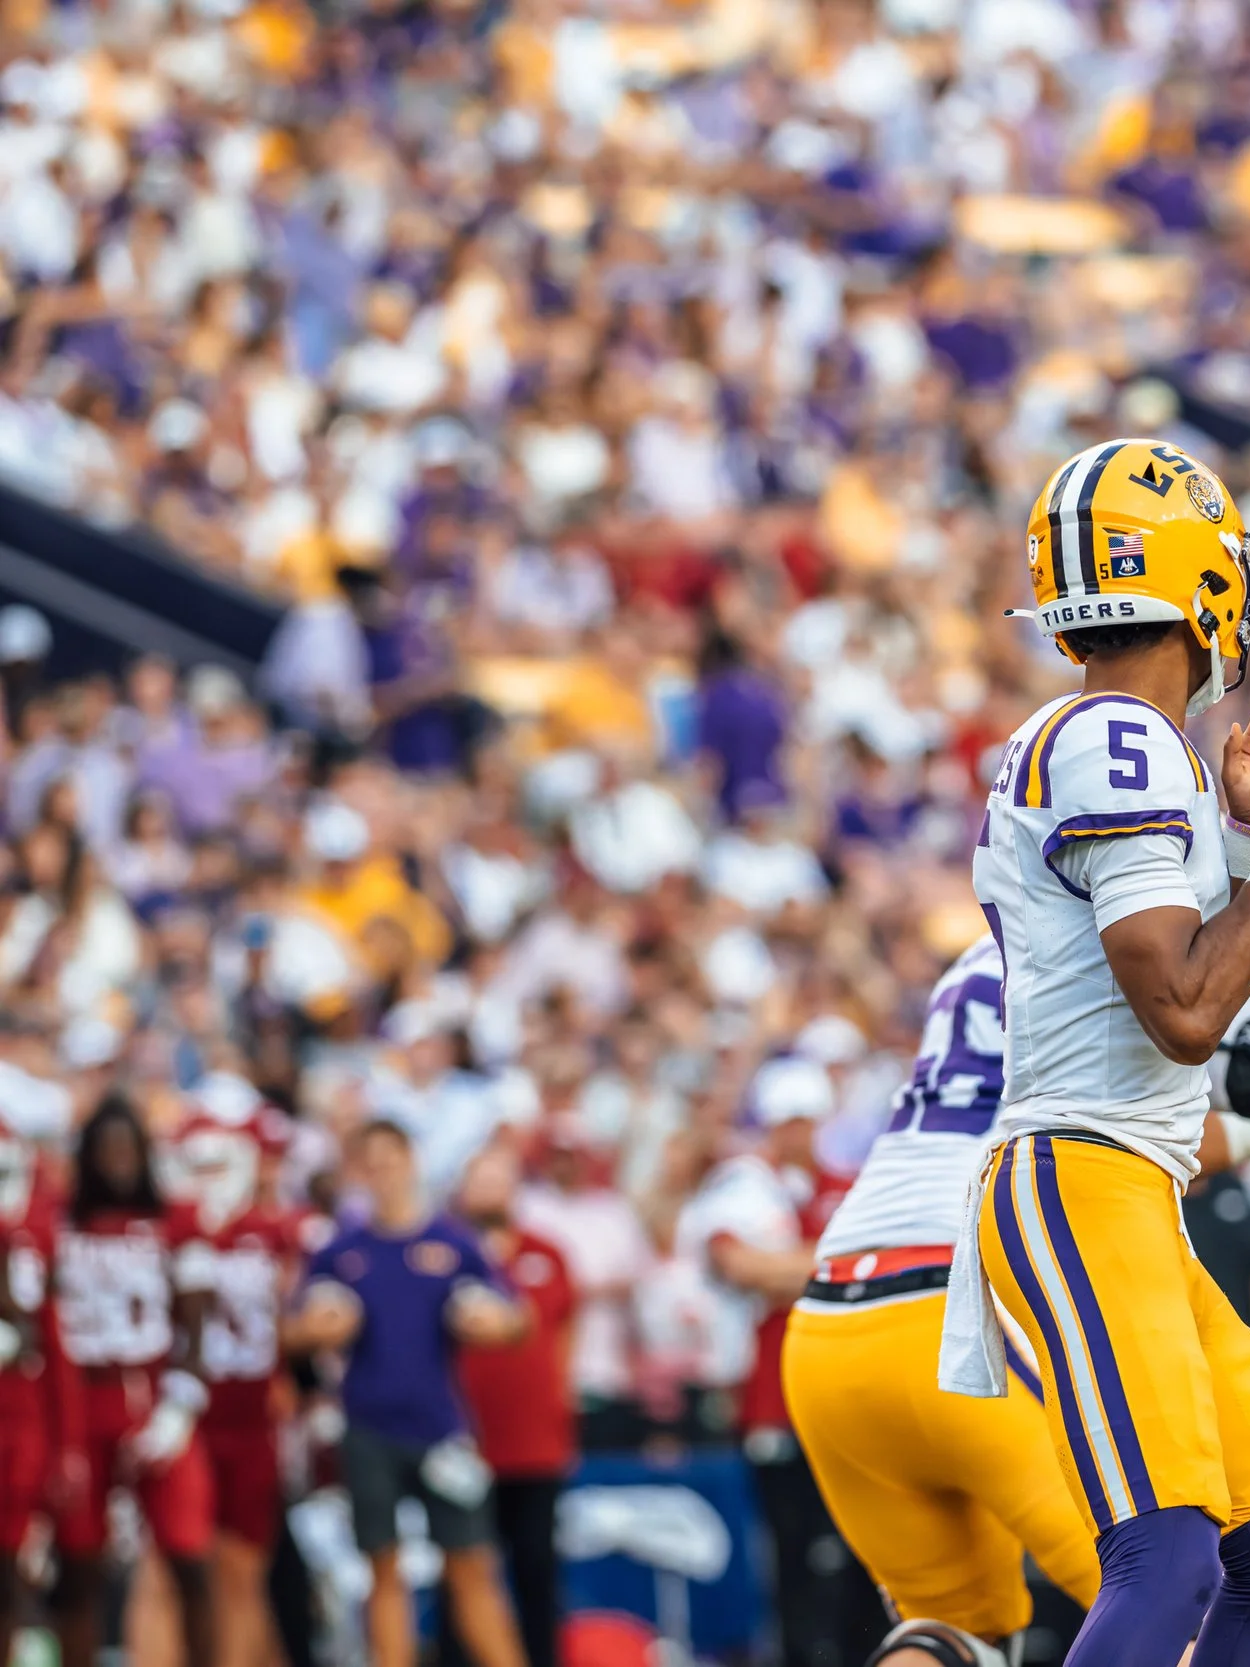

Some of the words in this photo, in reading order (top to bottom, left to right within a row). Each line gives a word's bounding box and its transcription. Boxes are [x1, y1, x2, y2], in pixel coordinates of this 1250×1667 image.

[1100, 564, 1109, 579] 5
[1042, 602, 1136, 627] TIGERS
[1108, 720, 1149, 791] 5
